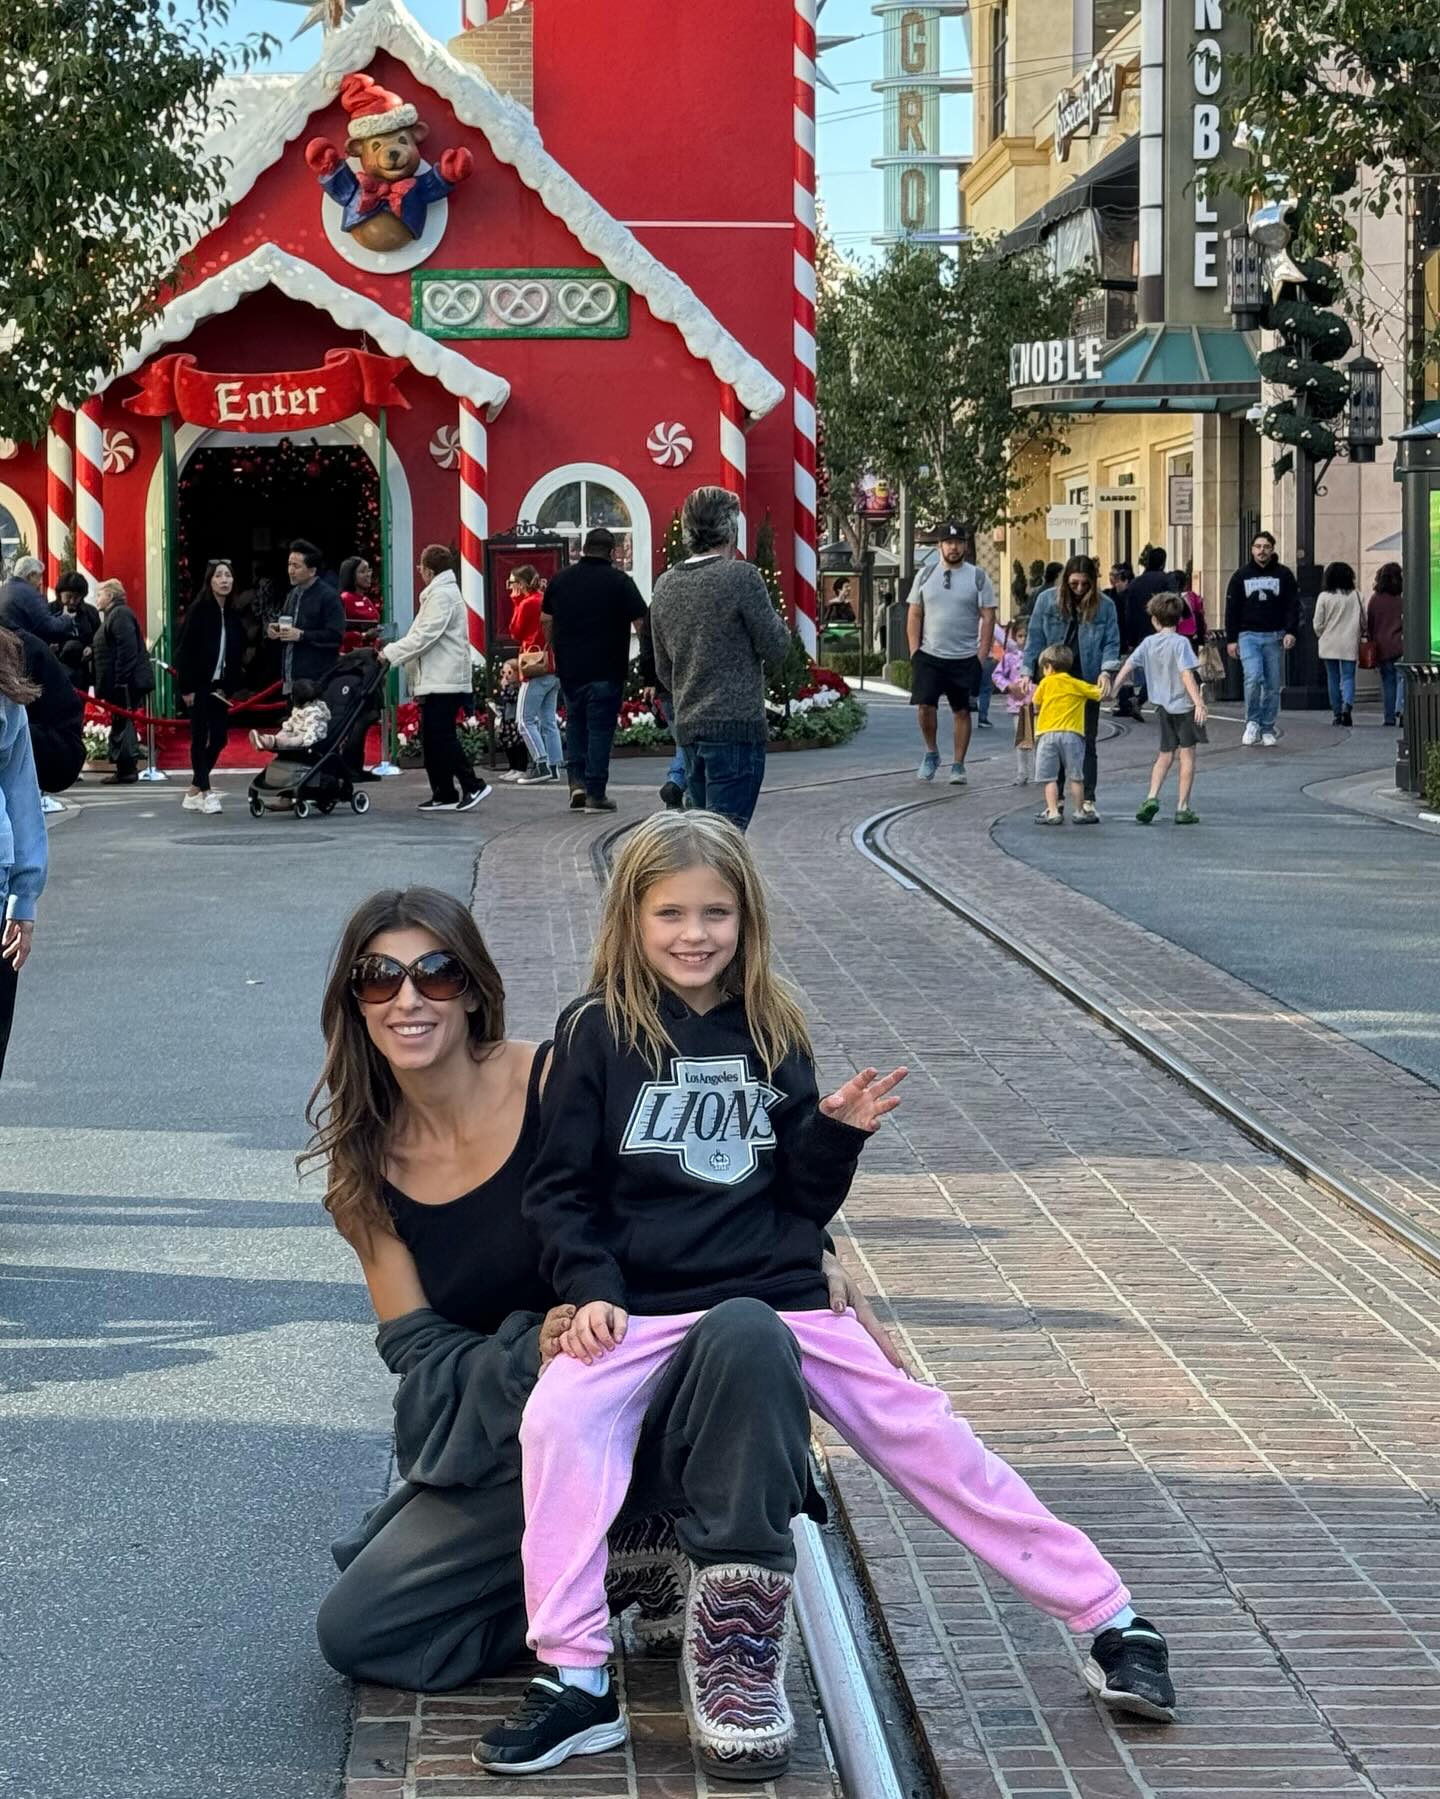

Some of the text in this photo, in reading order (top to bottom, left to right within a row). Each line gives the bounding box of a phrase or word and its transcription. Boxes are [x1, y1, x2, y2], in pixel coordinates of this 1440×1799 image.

[1019, 337, 1103, 385] NOBLE
[214, 381, 327, 424] Enter
[685, 1070, 739, 1085] Los Angeles
